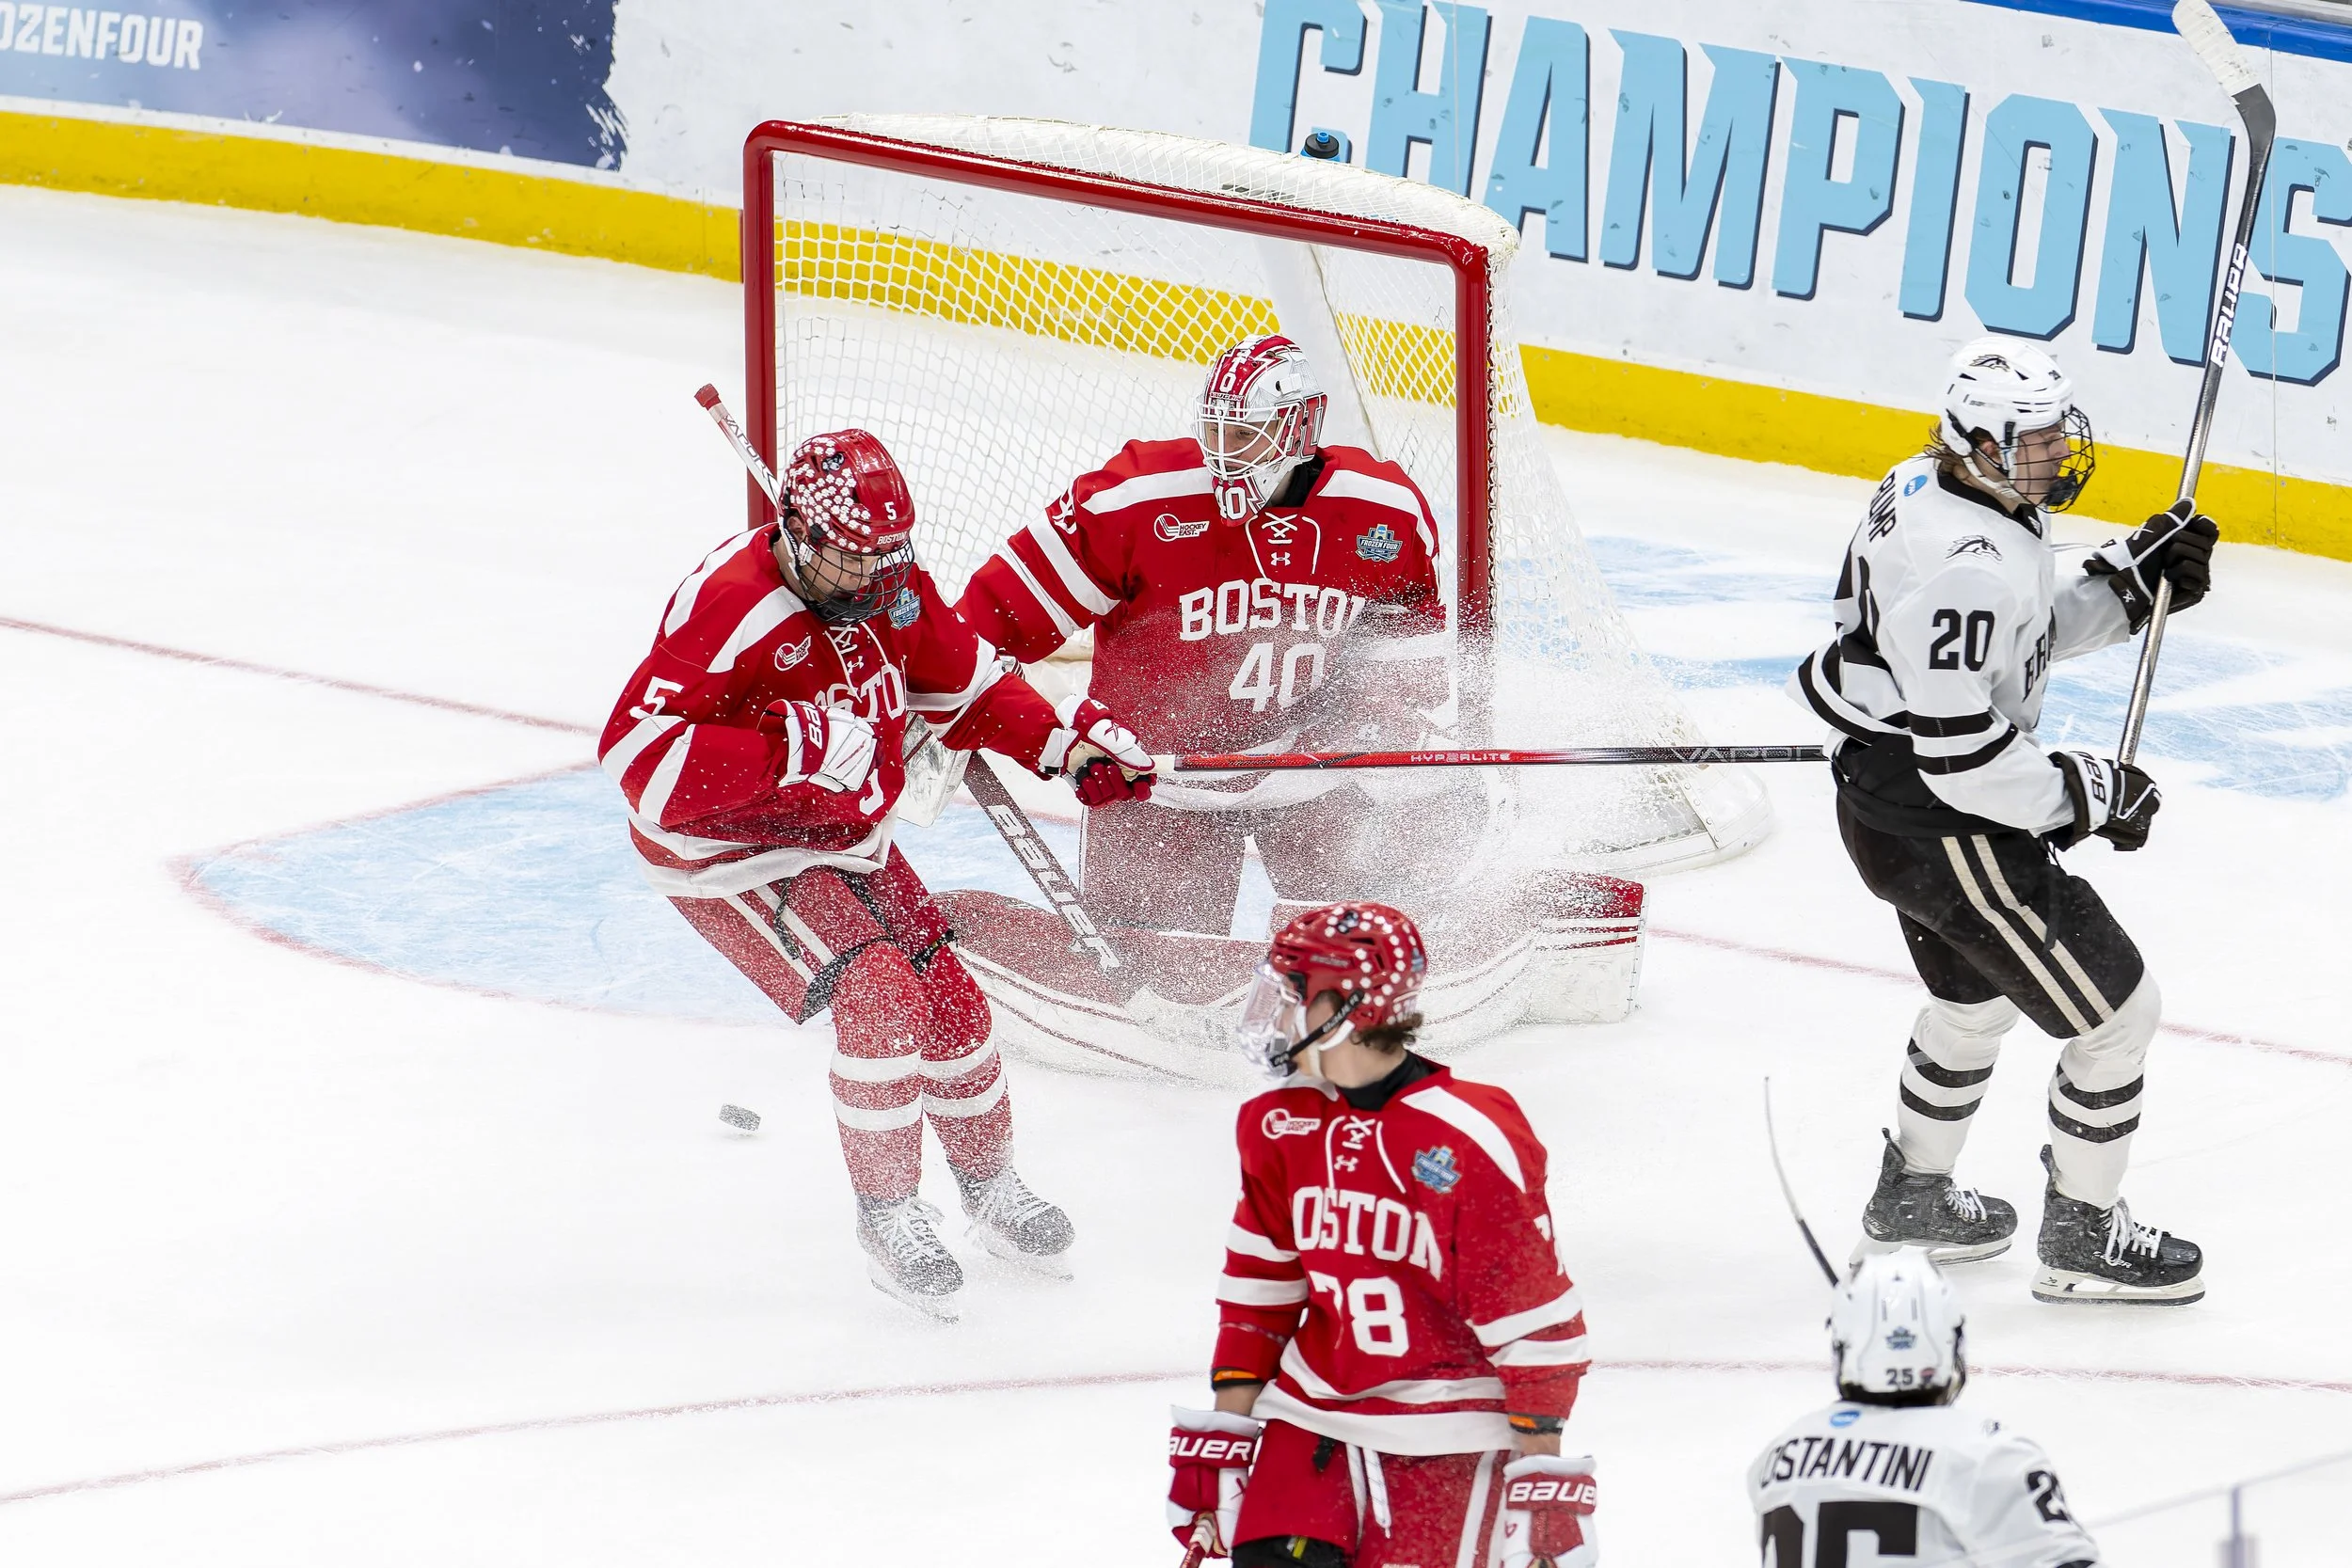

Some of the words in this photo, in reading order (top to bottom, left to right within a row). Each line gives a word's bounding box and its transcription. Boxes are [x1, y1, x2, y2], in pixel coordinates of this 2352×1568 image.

[1248, 0, 2352, 386] CHAMPIONS
[884, 500, 898, 521] 5
[1179, 522, 1207, 531] HOCKEY
[876, 531, 908, 546] BOSTON
[1360, 539, 1383, 548] FROZEN
[1929, 608, 1995, 672] 20
[628, 675, 685, 721] 5
[1229, 641, 1327, 712] 40
[1309, 1270, 1410, 1357] 78
[1885, 1367, 1915, 1386] 25
[2026, 1469, 2072, 1524] 2
